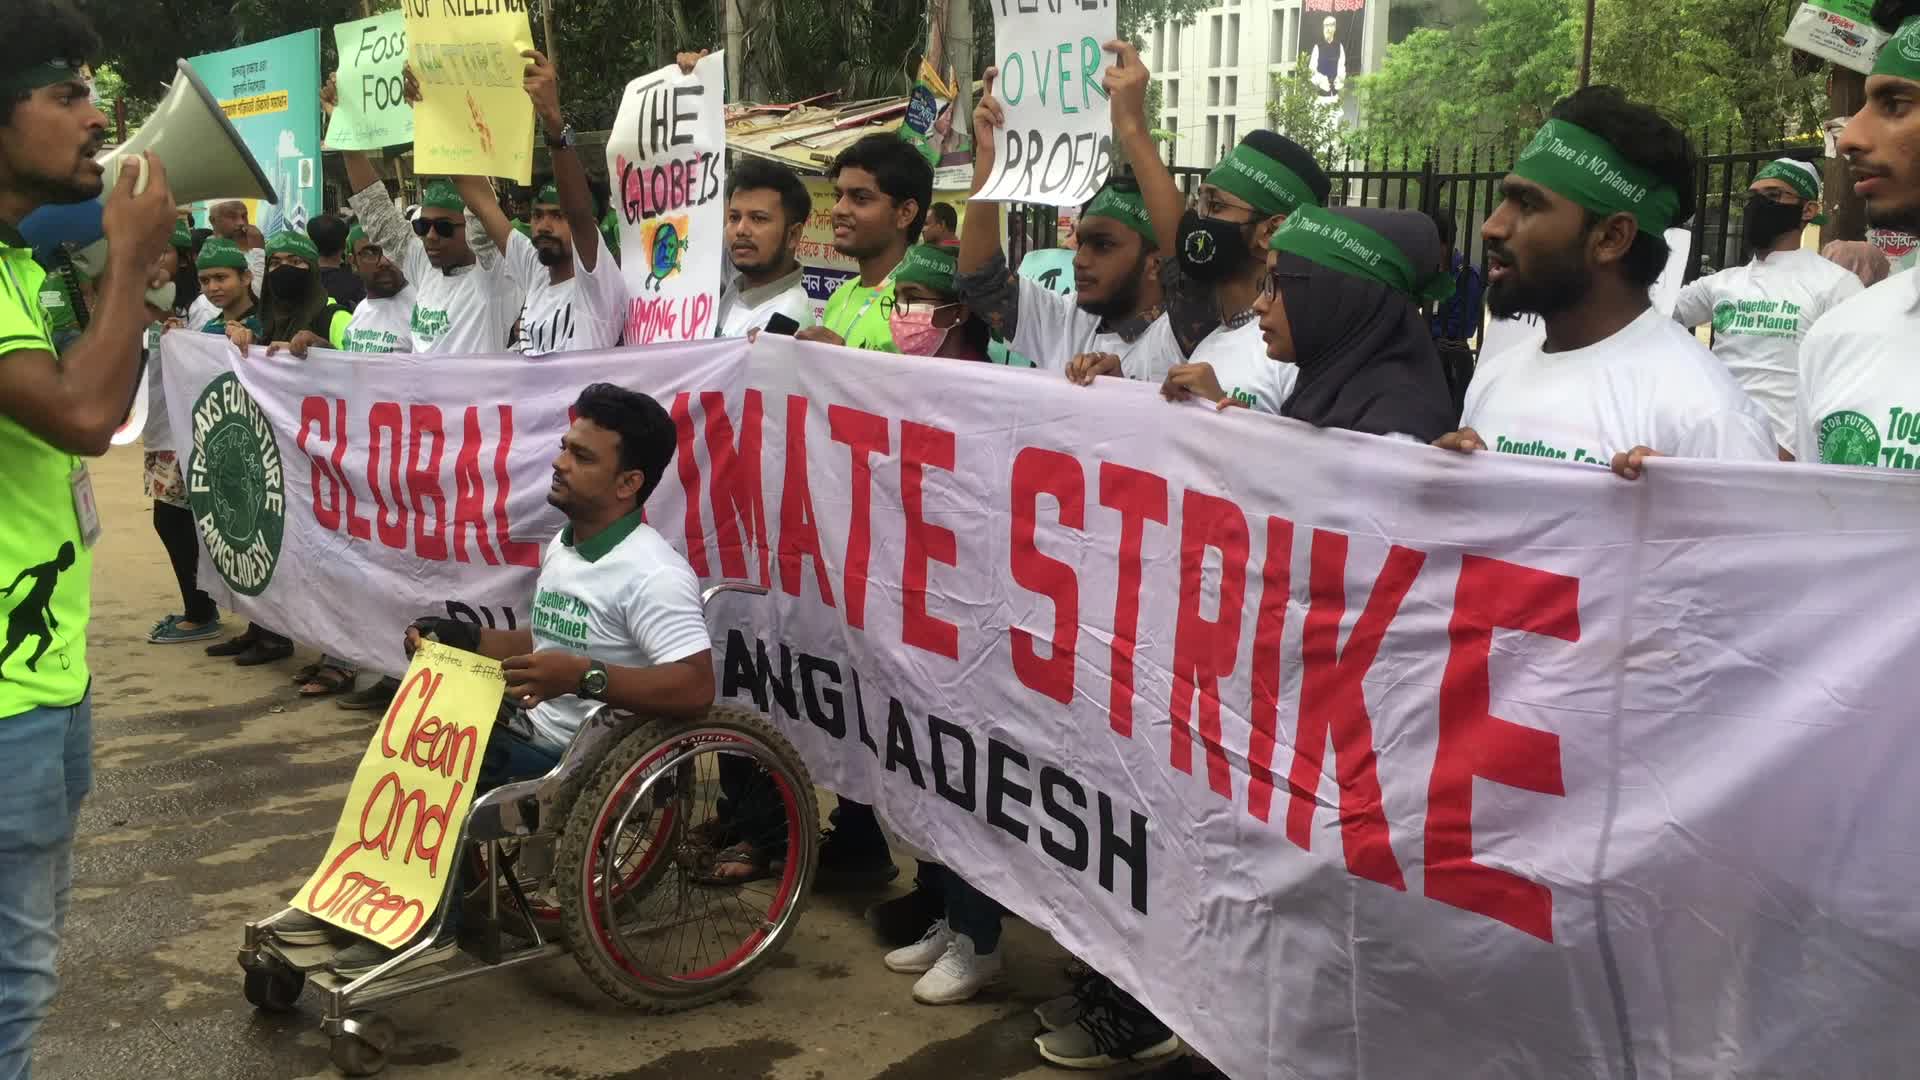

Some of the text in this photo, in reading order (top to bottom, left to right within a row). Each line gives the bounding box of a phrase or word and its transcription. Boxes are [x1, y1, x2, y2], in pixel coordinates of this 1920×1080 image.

[355, 26, 406, 67] Foss
[362, 74, 406, 113] FOO
[1002, 36, 1110, 114] OVER
[636, 79, 704, 161] THE
[697, 151, 720, 206] IS
[1252, 170, 1268, 185] NO
[1548, 138, 1647, 203] There is NO planet B
[1297, 216, 1321, 233] There
[1330, 227, 1347, 243] NO
[1342, 238, 1374, 262] planet
[1370, 253, 1381, 267] B
[1735, 313, 1798, 331] The Planet
[1738, 299, 1800, 315] Together For
[1823, 413, 1876, 443] FOR FUTURE
[1887, 406, 1920, 445] Tog
[191, 391, 223, 493] FRIDAYS
[249, 399, 282, 517] FUTURE
[199, 511, 274, 587] BANGLADESH
[533, 607, 548, 627] The
[550, 611, 588, 640] Planet
[571, 597, 589, 617] For
[297, 388, 1581, 943] GLOBAL IMATE STRIKE
[382, 667, 477, 783] Clean
[723, 627, 1149, 914] ANGLADESH
